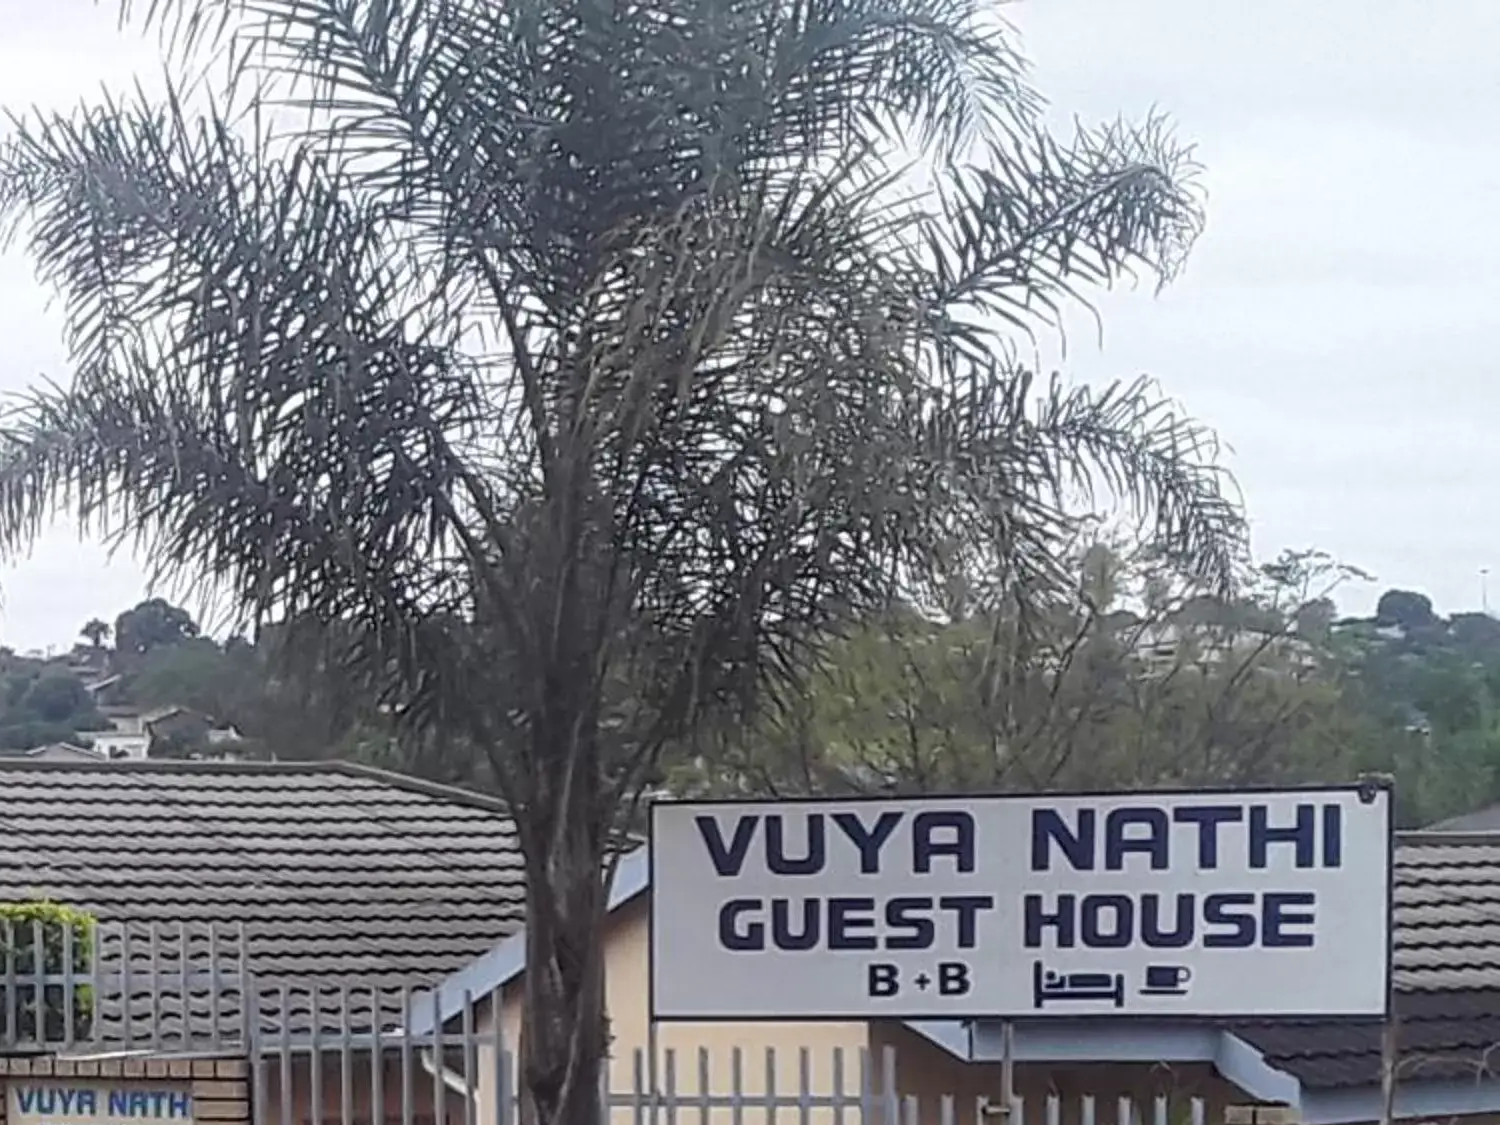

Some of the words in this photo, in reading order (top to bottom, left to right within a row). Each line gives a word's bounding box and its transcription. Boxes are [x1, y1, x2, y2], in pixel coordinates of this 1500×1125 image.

[696, 811, 976, 877] VUYA
[1031, 803, 1343, 872] NATHI
[718, 895, 994, 951] GUEST
[1024, 892, 1317, 949] HOUSE
[16, 1087, 97, 1116] VUYA
